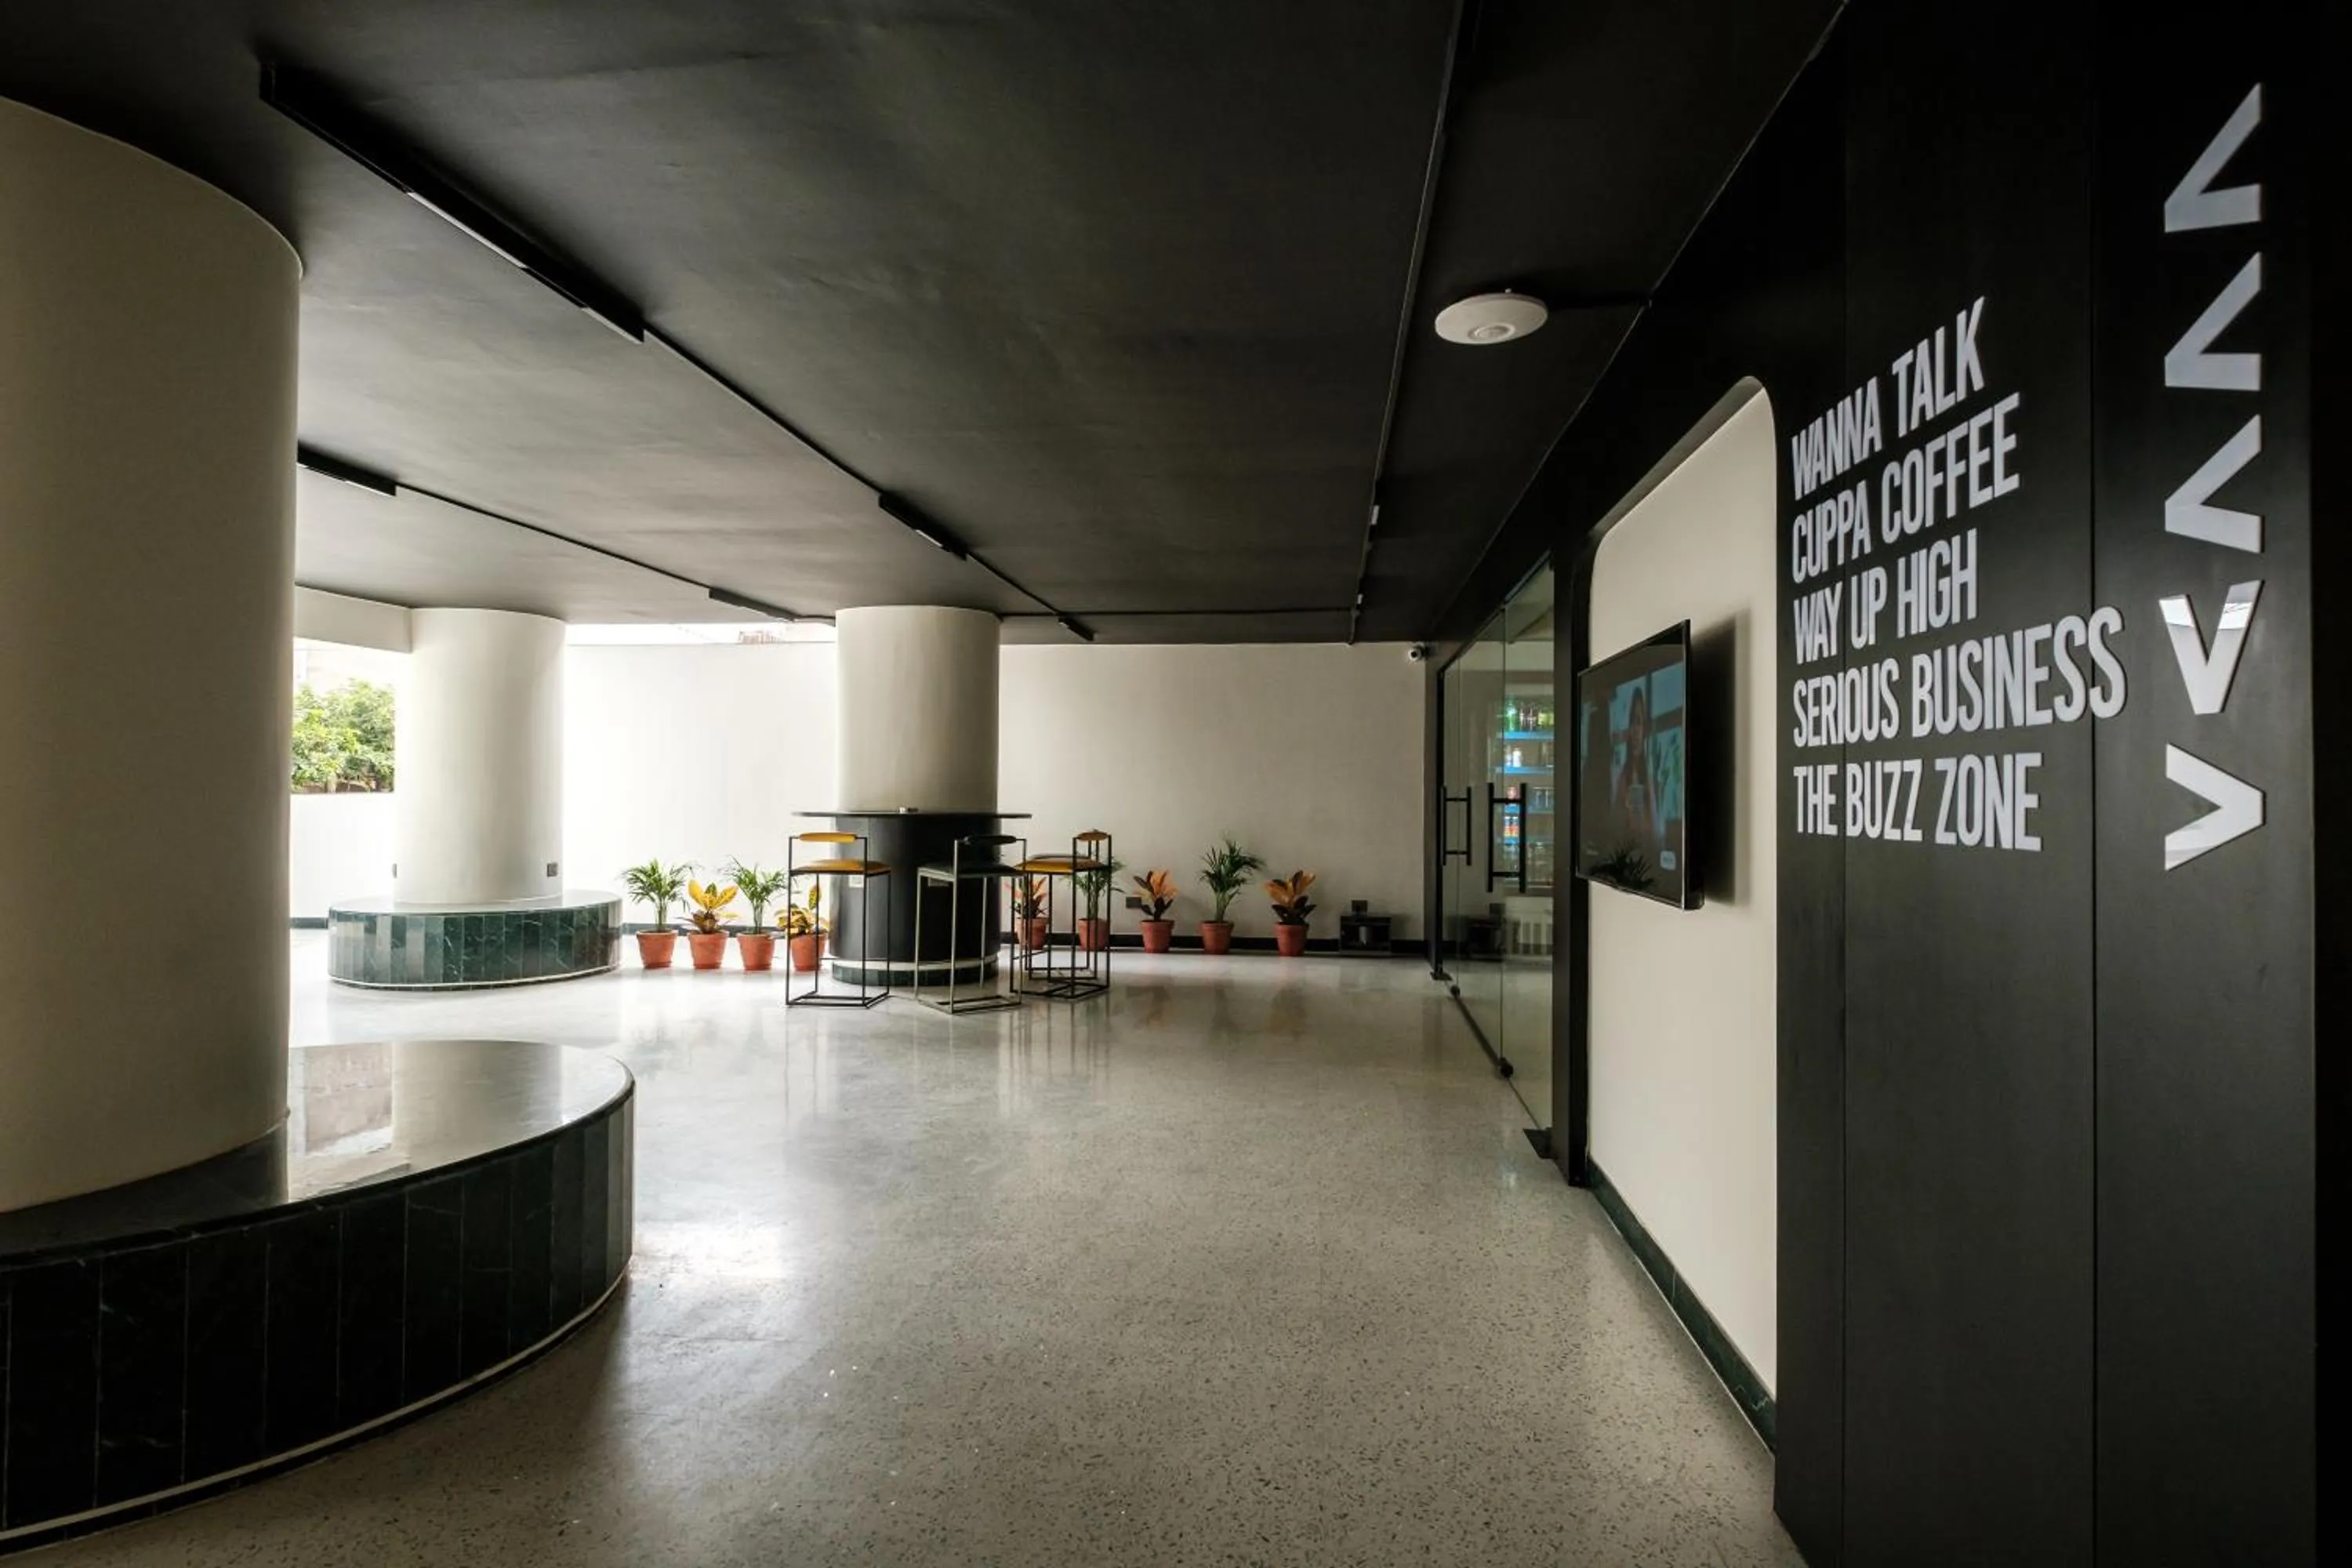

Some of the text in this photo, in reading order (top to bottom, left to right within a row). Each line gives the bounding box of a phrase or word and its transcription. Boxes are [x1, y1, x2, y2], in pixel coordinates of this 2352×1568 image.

[1791, 296, 1985, 501] WANNA TALK
[1792, 391, 2020, 585] CUPPA COFFEE
[1793, 527, 1978, 666] WAY UP HIGH
[1792, 605, 2126, 748] SERIOUS BUSINESS
[1793, 751, 2042, 853] THE BUZZ ZONE
